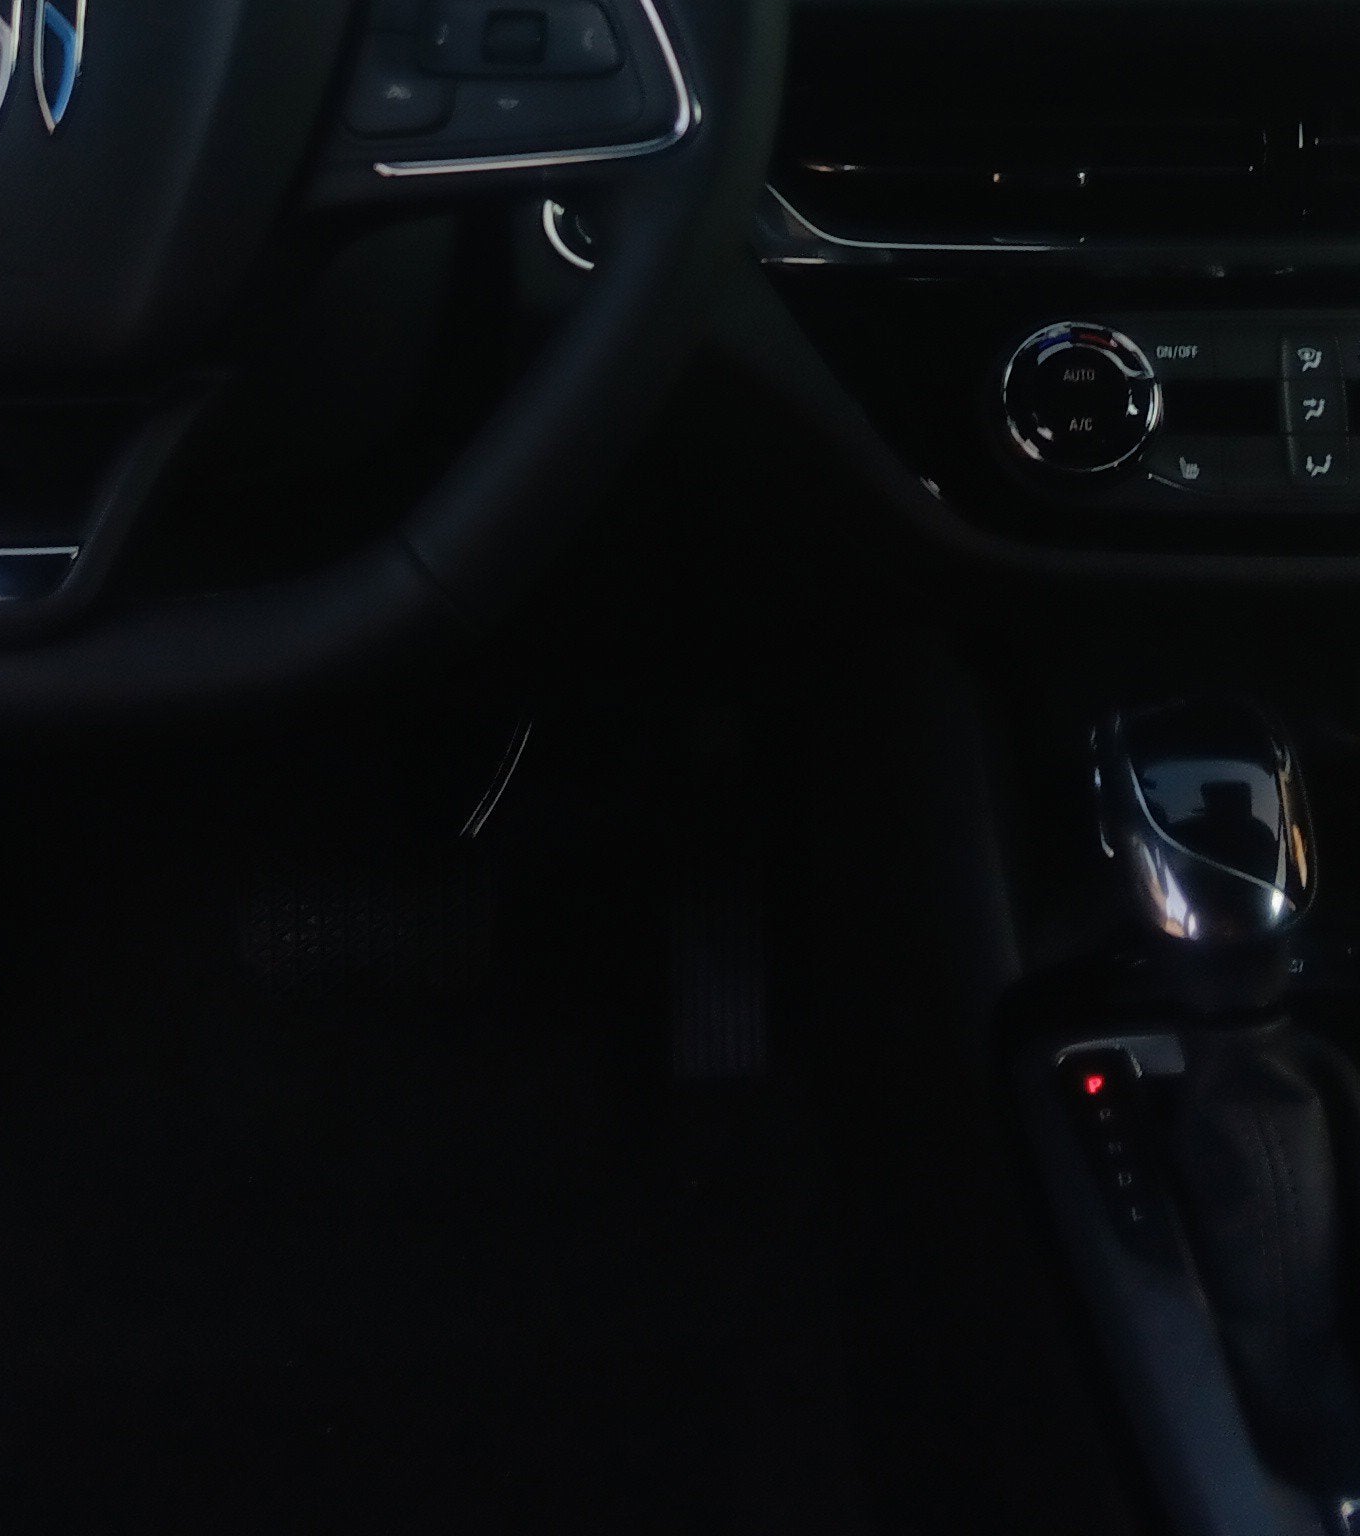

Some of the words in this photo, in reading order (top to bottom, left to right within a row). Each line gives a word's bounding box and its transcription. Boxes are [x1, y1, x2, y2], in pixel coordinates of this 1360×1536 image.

[1156, 345, 1199, 360] ON/OFF
[1063, 369, 1096, 382] AUTO
[1069, 417, 1093, 432] A/C
